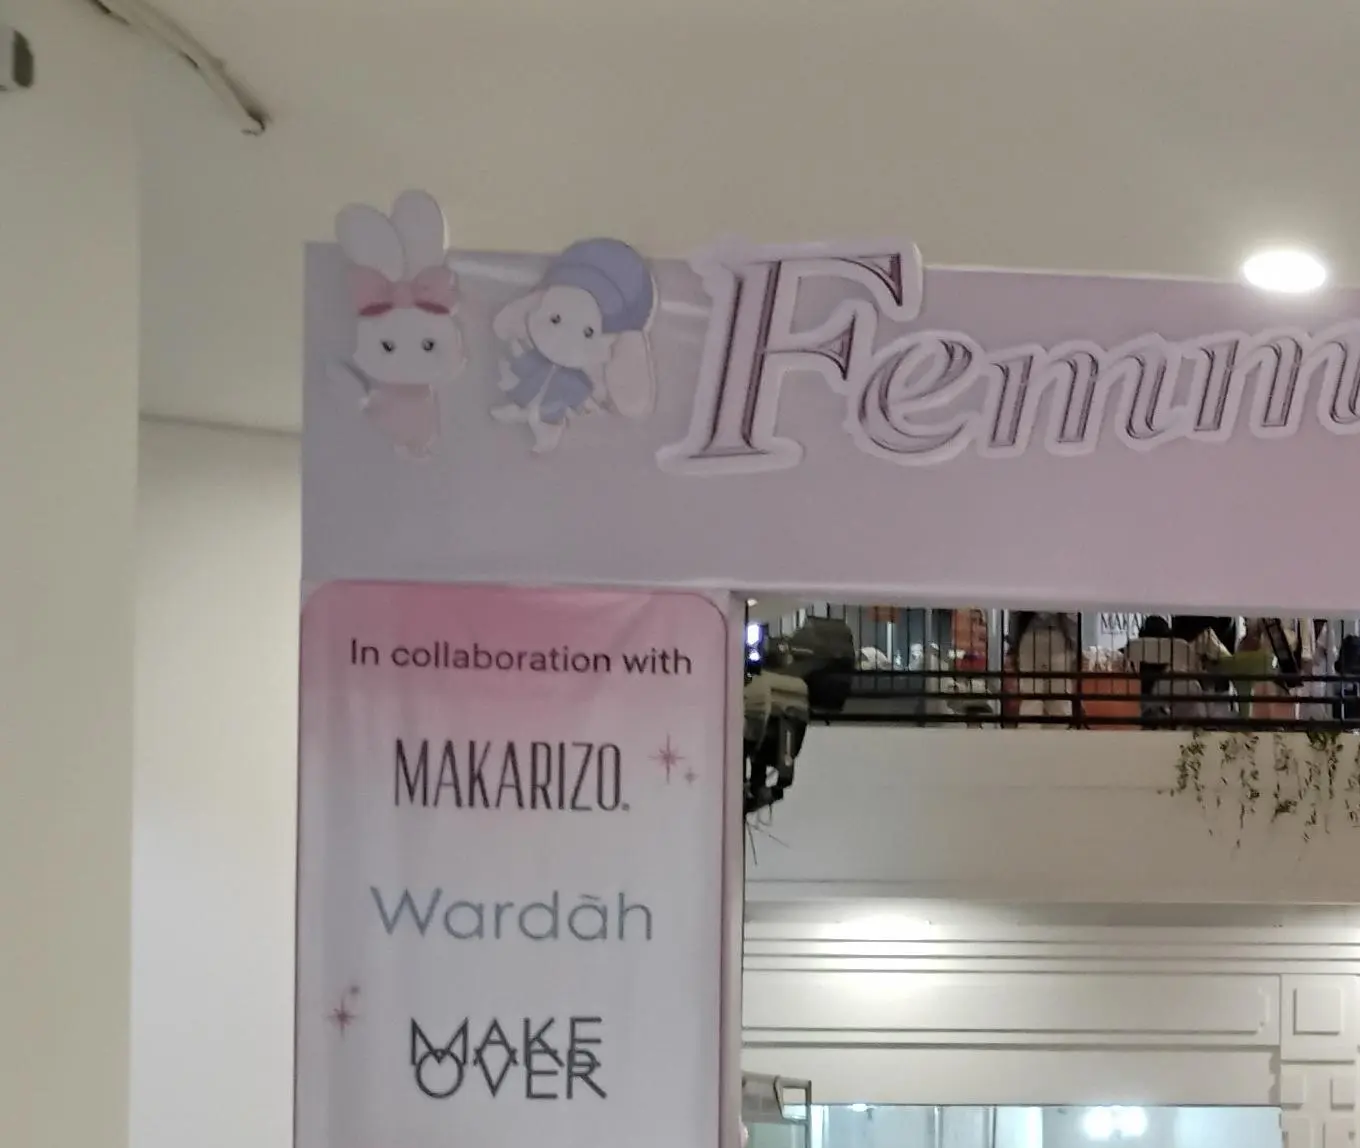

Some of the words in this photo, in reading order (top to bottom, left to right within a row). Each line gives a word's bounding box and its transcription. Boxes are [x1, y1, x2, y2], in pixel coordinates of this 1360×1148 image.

[350, 638, 380, 667] In
[391, 641, 612, 674] collaboration
[623, 647, 693, 675] with
[410, 1016, 604, 1067] MAKE
[414, 1047, 608, 1099] OVER
